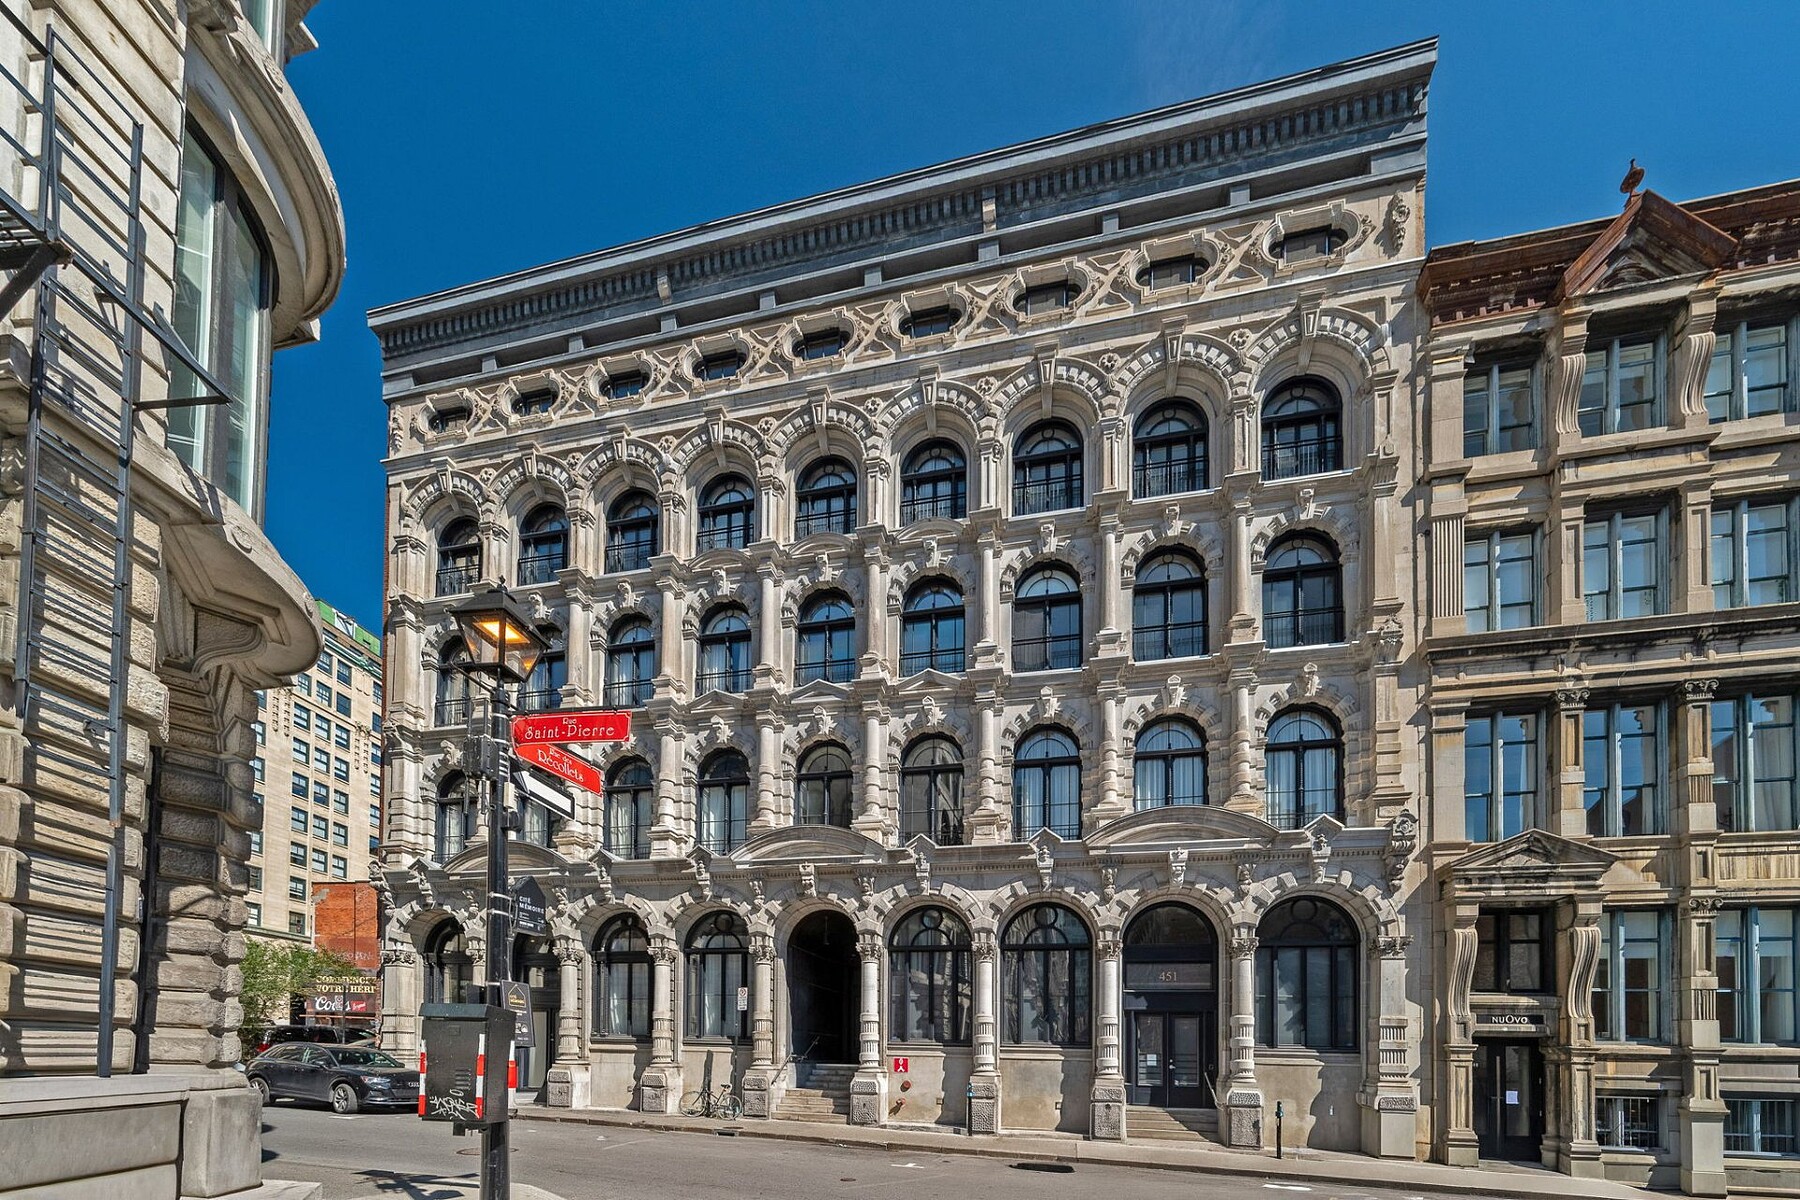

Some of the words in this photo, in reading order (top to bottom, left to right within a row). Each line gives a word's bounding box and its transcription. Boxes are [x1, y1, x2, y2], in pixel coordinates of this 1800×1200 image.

[562, 717, 578, 725] Rue
[525, 724, 615, 739] Saint-Pierre
[549, 747, 561, 758] Rue
[562, 755, 573, 765] des
[537, 749, 584, 782] Récollets
[1159, 971, 1178, 982] 451
[1491, 1014, 1529, 1024] NUOVO
